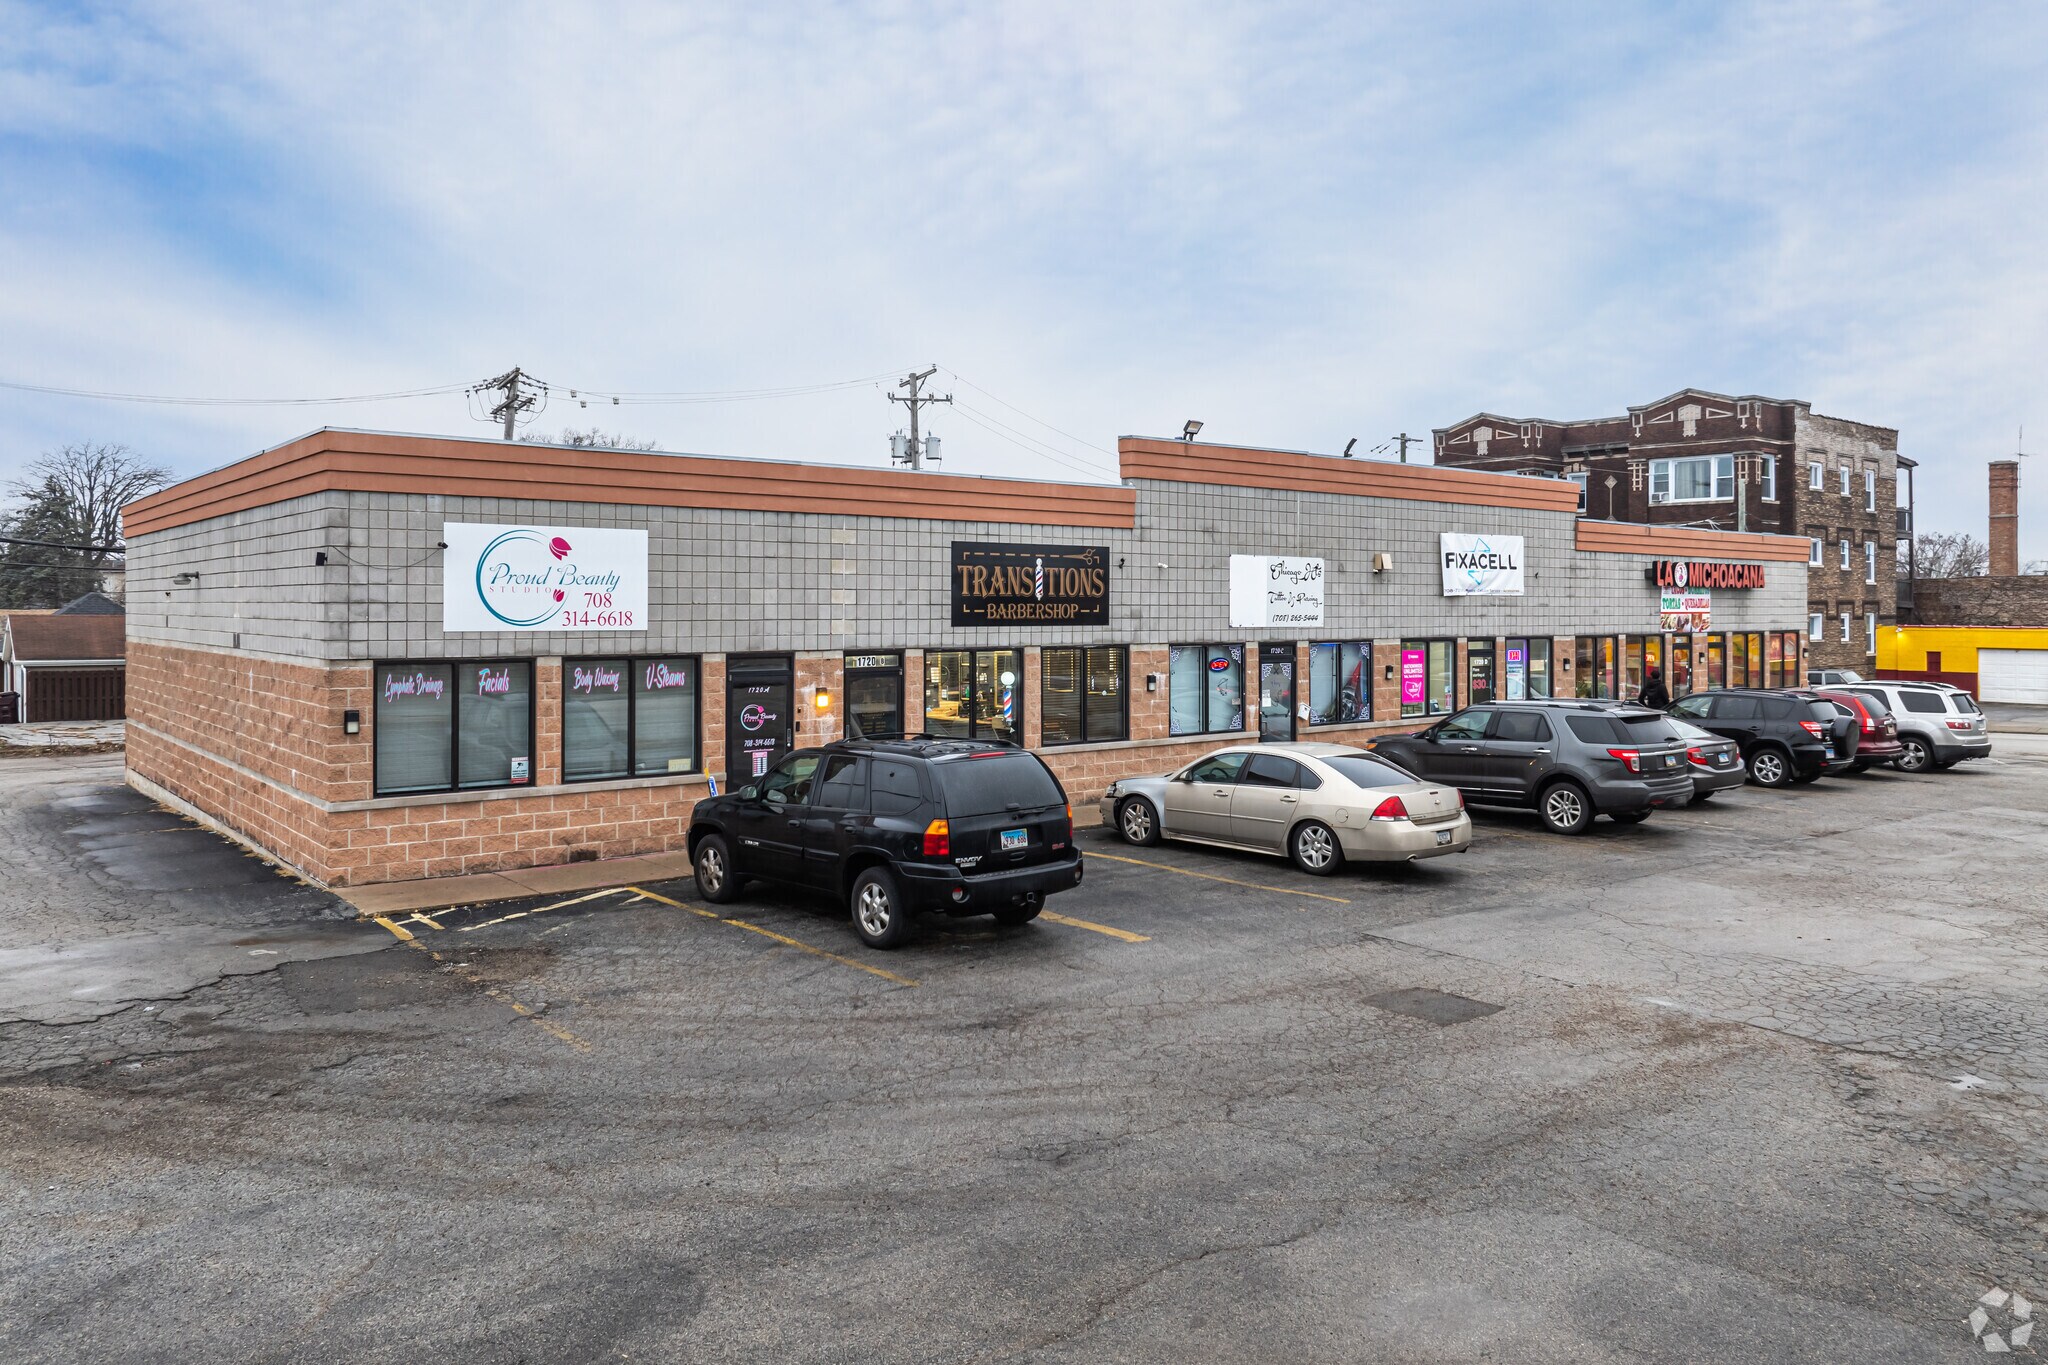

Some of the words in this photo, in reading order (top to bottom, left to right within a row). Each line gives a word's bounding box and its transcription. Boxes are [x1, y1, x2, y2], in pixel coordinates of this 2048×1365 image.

[1445, 552, 1517, 570] FIXACELL
[490, 563, 552, 585] Proud
[557, 564, 621, 592] Beauty
[1657, 560, 1674, 587] LA
[1688, 561, 1765, 589] MICHOACANA
[584, 592, 612, 608] 708
[1662, 597, 1681, 610] TORTAS
[562, 610, 633, 627] 314-6618
[986, 603, 1079, 619] BARBERSHOP
[857, 656, 876, 667] 1720
[1211, 661, 1228, 669] OPEN
[478, 667, 510, 696] Facials
[573, 667, 593, 694] Body
[594, 666, 620, 692] Waxing
[646, 663, 685, 689] V-Steams
[1473, 679, 1487, 689] $30
[384, 673, 415, 702] Lymphatic
[416, 672, 444, 700] Drainage
[743, 712, 759, 721] Proud
[760, 712, 777, 720] Beauty
